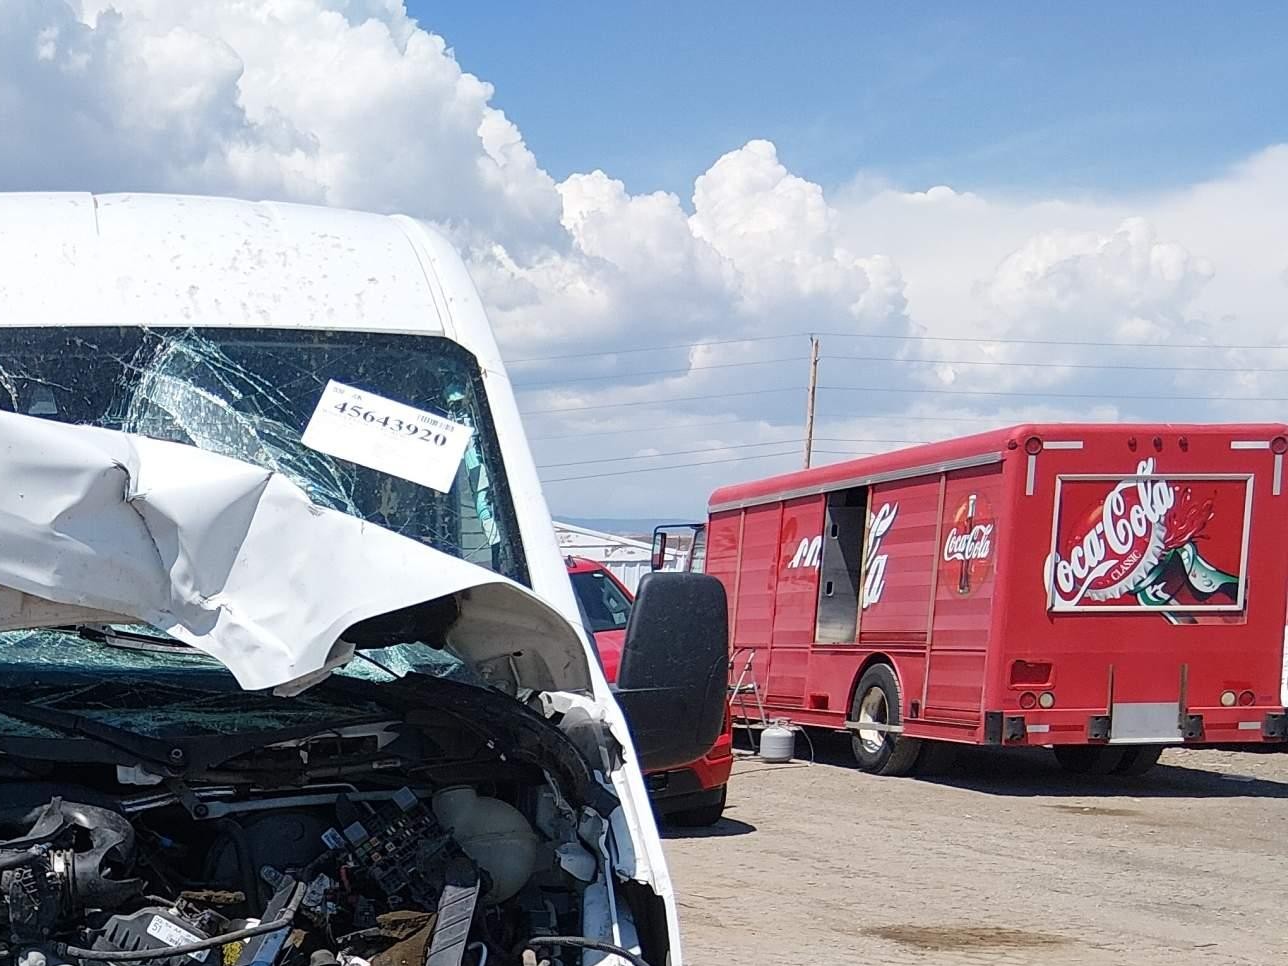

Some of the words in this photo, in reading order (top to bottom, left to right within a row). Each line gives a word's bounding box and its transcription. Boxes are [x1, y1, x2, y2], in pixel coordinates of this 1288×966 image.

[333, 401, 448, 447] 45643920
[943, 523, 994, 561] Coca-Cola
[1044, 457, 1175, 607] Coca-Cola
[1110, 549, 1142, 581] CLASSIC
